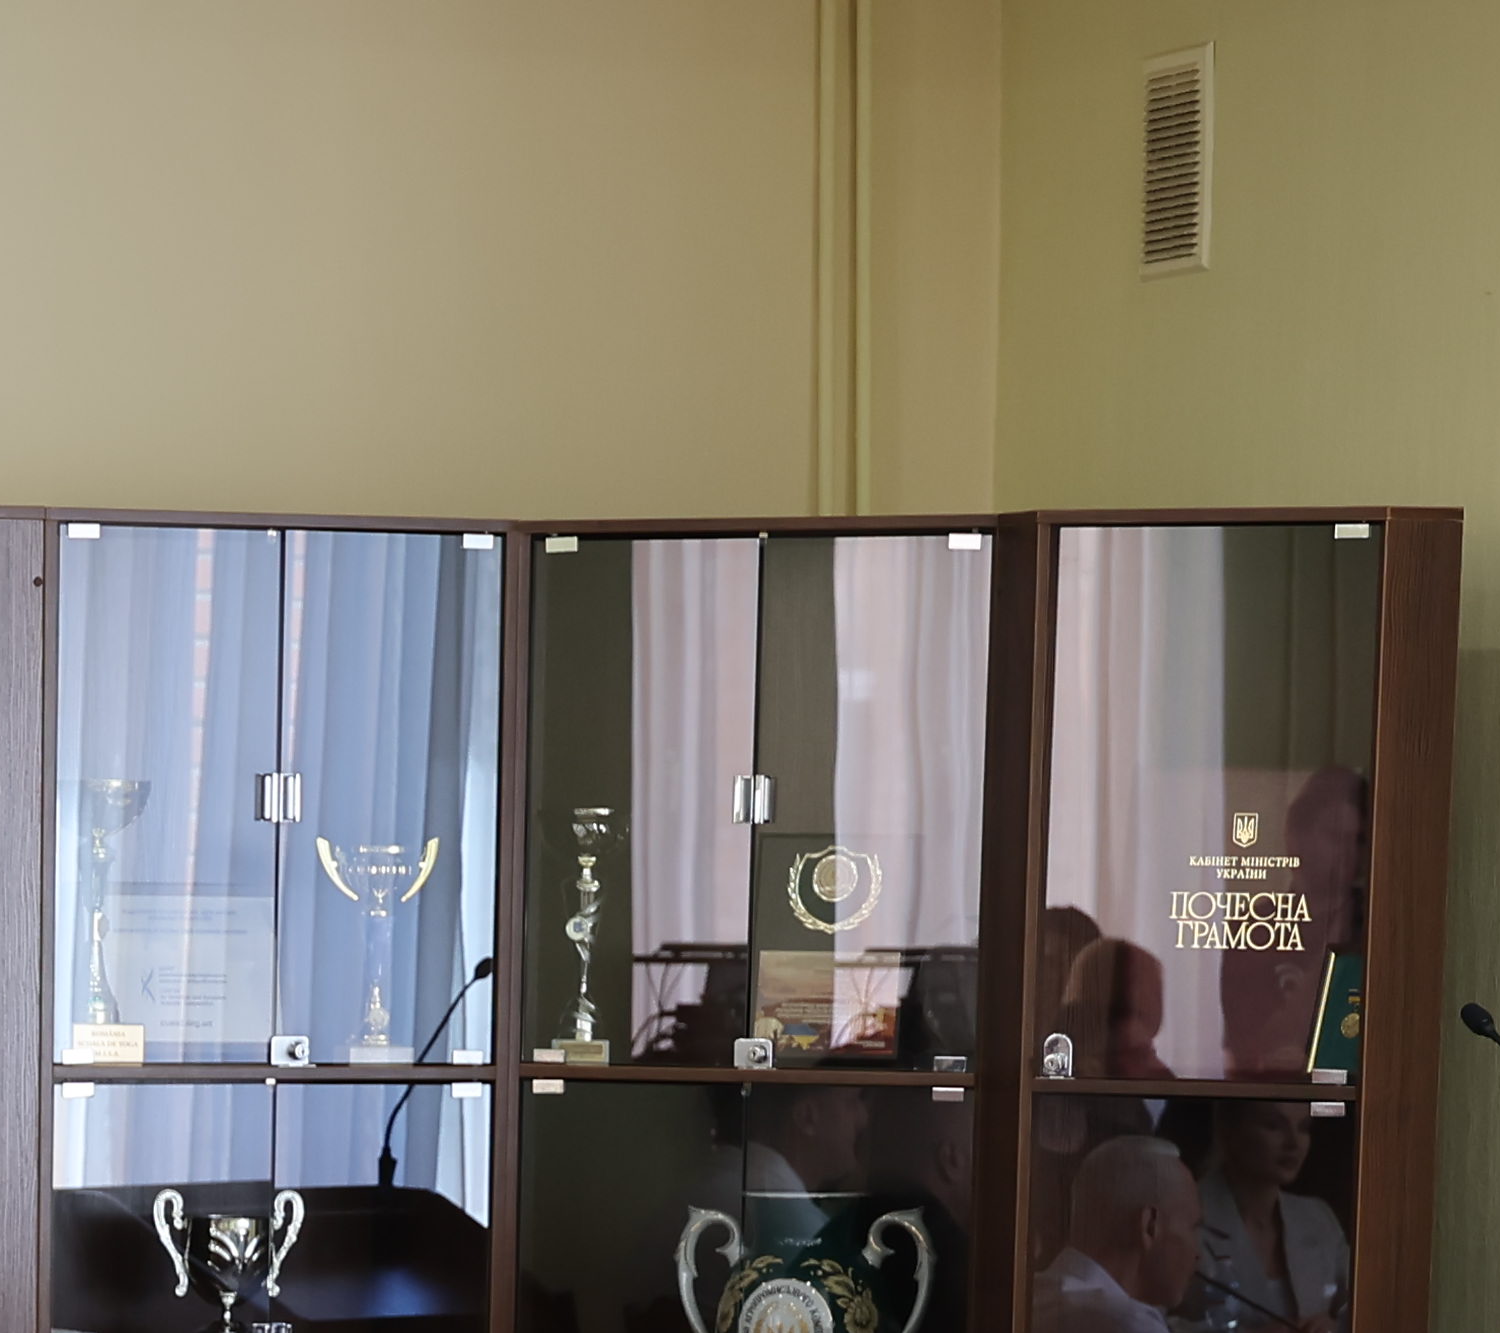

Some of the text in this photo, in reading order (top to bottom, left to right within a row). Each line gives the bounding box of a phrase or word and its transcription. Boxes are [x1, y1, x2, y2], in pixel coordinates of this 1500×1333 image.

[1188, 855, 1301, 868] КАБІНЕТ МІНІСТРІВ
[1215, 868, 1268, 880] УКРАЇНИ
[1168, 891, 1313, 922] ПОЧЕСНА
[1174, 919, 1306, 951] ГРАМОТА
